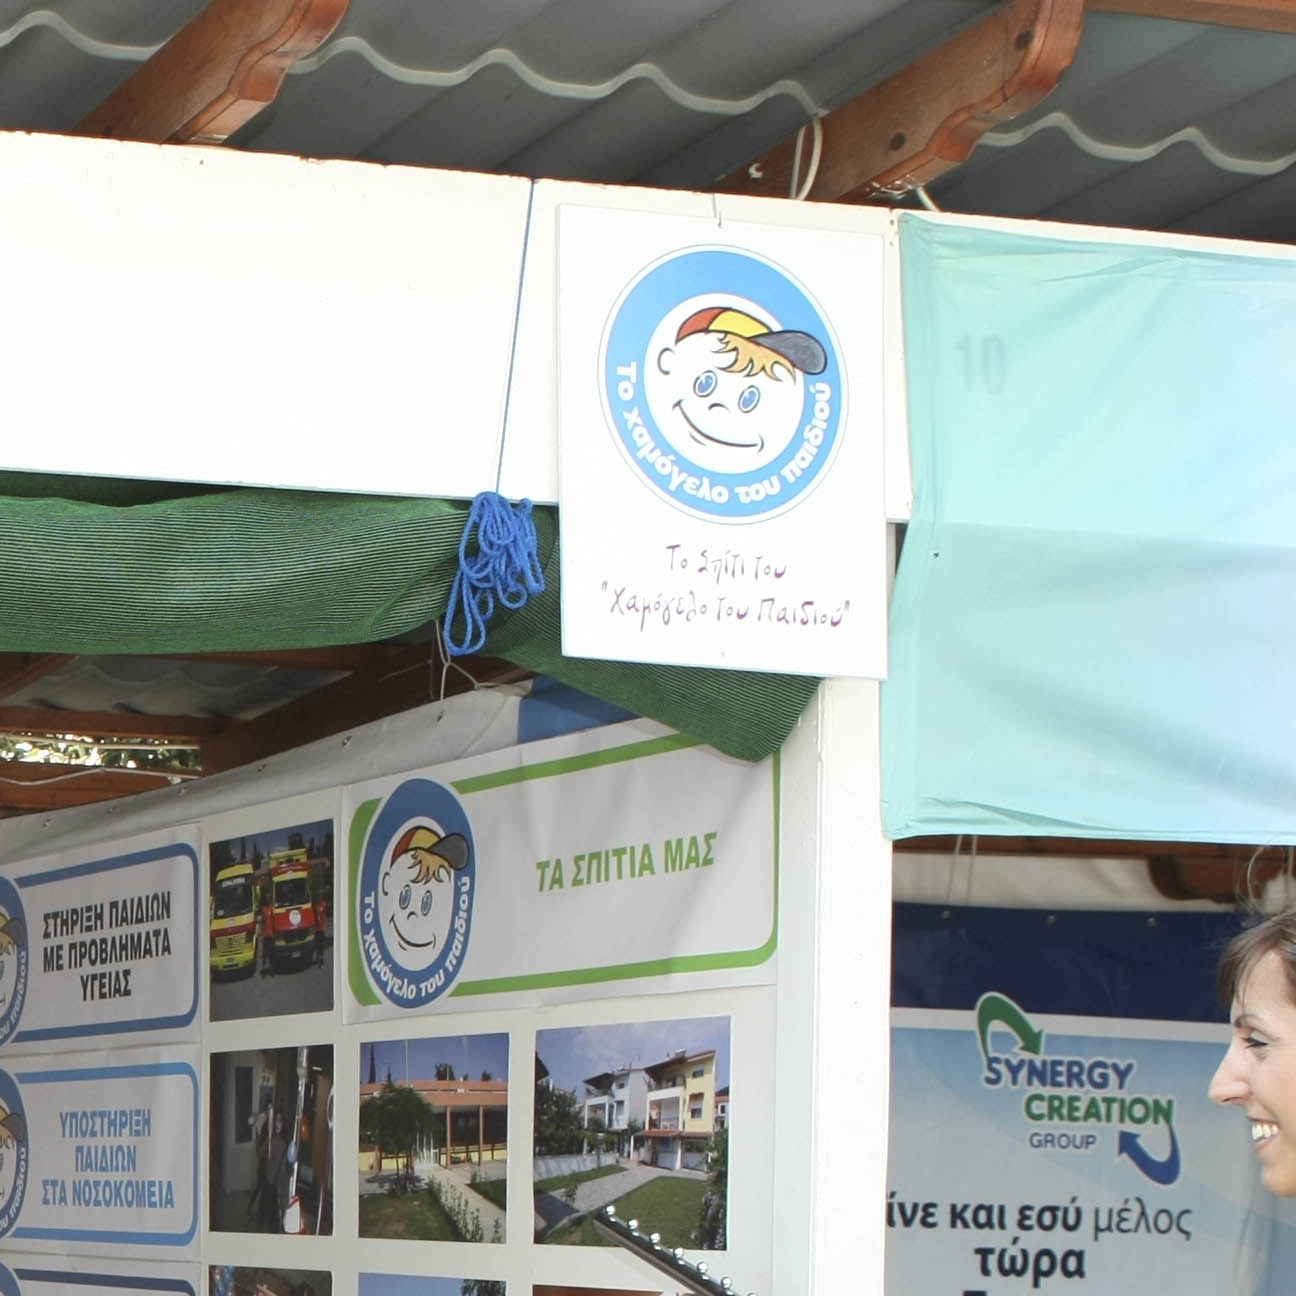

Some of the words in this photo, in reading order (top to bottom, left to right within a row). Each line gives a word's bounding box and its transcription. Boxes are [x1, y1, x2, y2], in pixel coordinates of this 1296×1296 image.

[616, 361, 637, 400] Το
[781, 382, 831, 484] παιδιού
[623, 410, 729, 503] χαμόγελο
[735, 479, 781, 504] του
[665, 543, 688, 572] Το
[536, 859, 563, 892] ΤΑ
[571, 844, 655, 887] ΣΠΙΤΙΑ
[664, 832, 716, 874] ΜΑΣ
[42, 906, 104, 940] ΣΤΗΡΙΞΗ
[109, 891, 171, 928] ΠΑΙΔΙΩΝ
[364, 891, 375, 924] Το
[445, 875, 471, 975] παιδιού
[43, 946, 65, 973] ΜΕ
[68, 928, 171, 970] ΠΡΟΒΛΗΜΑΤΑ
[364, 927, 416, 1000] χαμόγελο
[80, 970, 131, 1001] ΥΓΕΙΑΣ
[420, 970, 445, 997] του
[984, 1056, 1133, 1091] SYNERGY
[59, 1109, 151, 1138] ΥΠΟΣΤΗΡΙΞΗ
[1024, 1093, 1173, 1125] CREATION
[75, 1144, 137, 1173] ΠΑΙΔΙΩΝ
[1029, 1132, 1097, 1150] GROUP
[42, 1180, 68, 1206] ΣΤΑ
[72, 1179, 174, 1209] ΝΟΣΟΚΟΜΕΙΑ
[950, 1201, 1005, 1232] και
[1017, 1196, 1082, 1233] εσύ
[1094, 1196, 1193, 1241] μέλος
[974, 1238, 1086, 1288] τώρα
